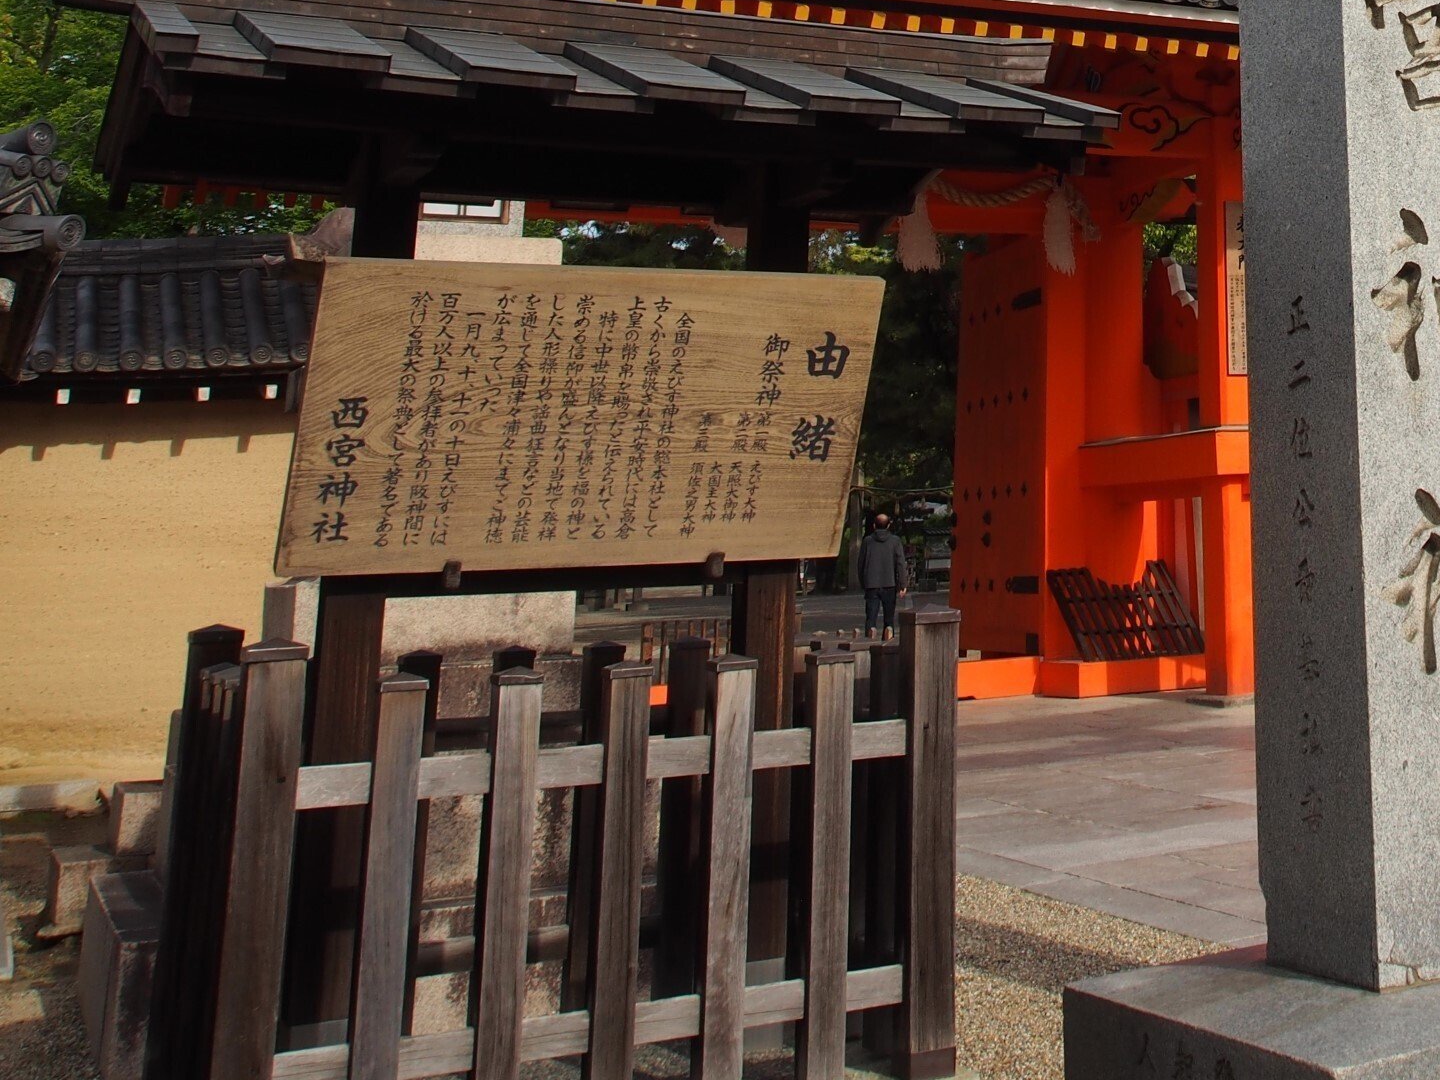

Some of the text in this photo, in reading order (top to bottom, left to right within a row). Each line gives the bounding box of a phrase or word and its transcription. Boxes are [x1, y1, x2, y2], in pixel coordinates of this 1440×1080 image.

[755, 333, 790, 407] 御祭神
[789, 331, 850, 462] 由緒
[310, 396, 369, 543] 西宮神社
[702, 460, 723, 524] 大国主大神
[741, 460, 762, 523] えびす大神
